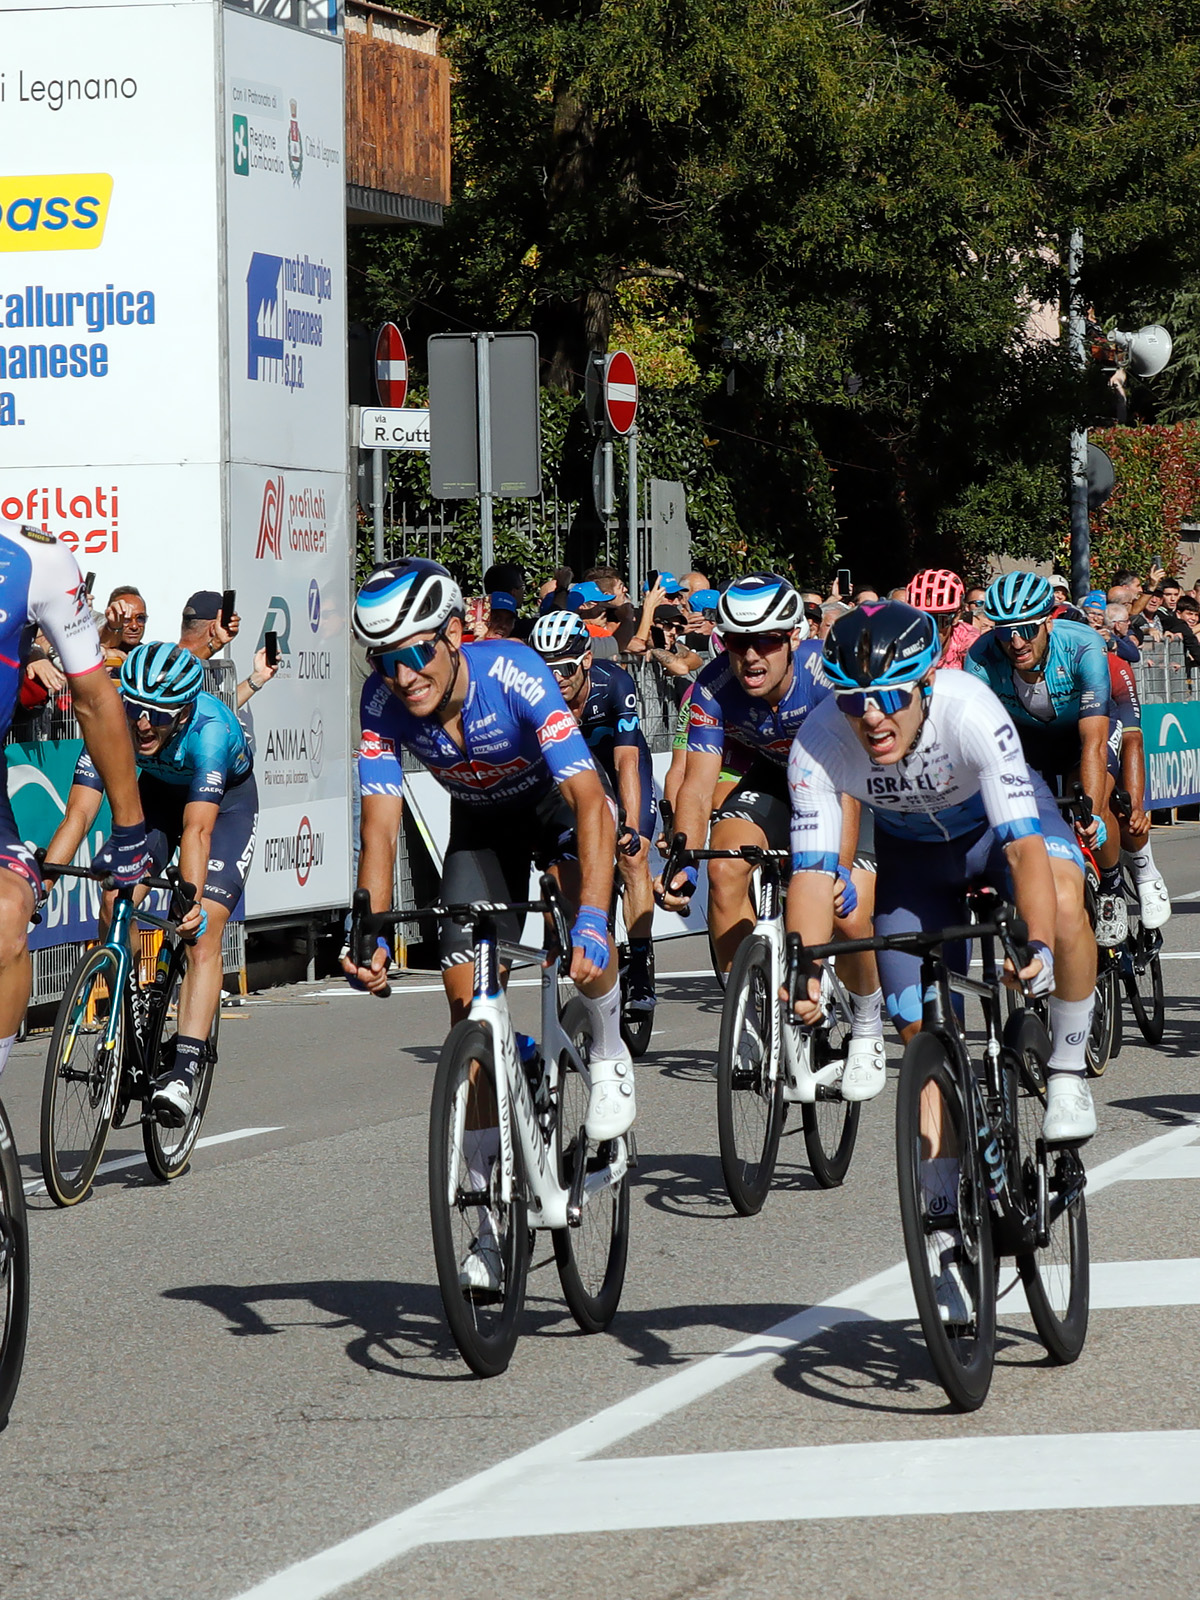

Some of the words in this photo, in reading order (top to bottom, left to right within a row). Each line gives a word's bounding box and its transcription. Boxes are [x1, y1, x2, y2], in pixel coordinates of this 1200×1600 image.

[18, 70, 138, 112] Legnano
[249, 126, 277, 153] Regione
[249, 149, 285, 175] Lombardia
[284, 253, 332, 304] metallurgica
[374, 414, 387, 424] via
[374, 427, 390, 442] R.
[392, 427, 431, 443] Cutt
[288, 487, 326, 525] profilati
[287, 519, 328, 554] lonatesi
[298, 651, 331, 680] ZURICH
[488, 655, 548, 708] Alpecin
[264, 728, 308, 762] ANIMA
[866, 773, 937, 795] ISRAEL
[1148, 750, 1181, 800] BANCO
